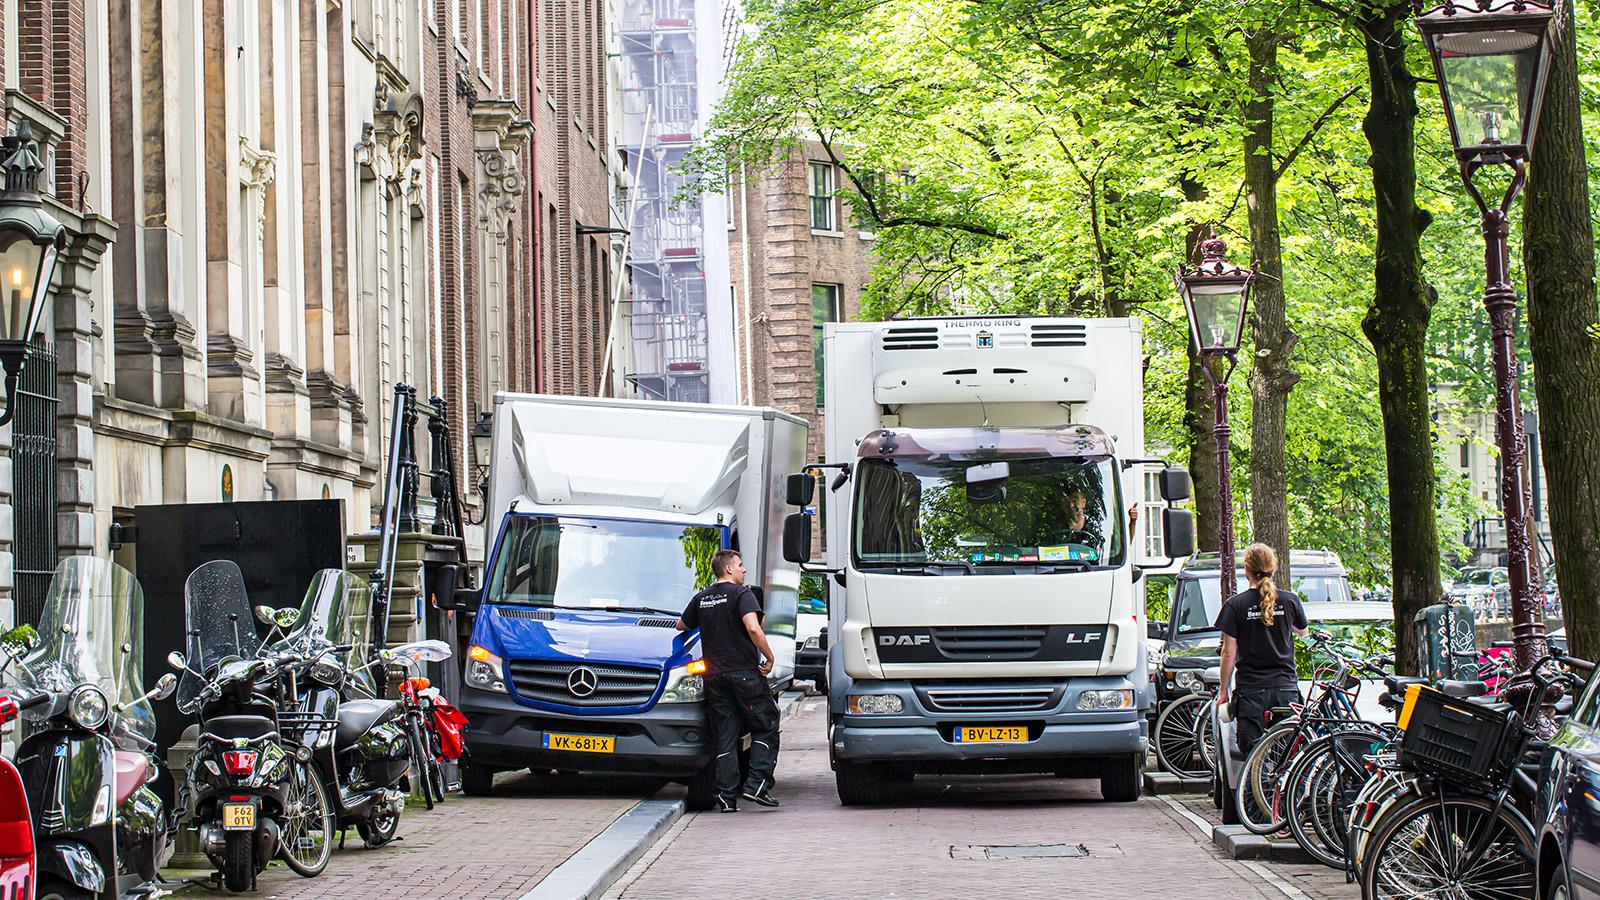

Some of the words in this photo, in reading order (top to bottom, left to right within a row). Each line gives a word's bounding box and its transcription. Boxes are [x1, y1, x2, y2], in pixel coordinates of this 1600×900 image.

[944, 320, 991, 328] THERMO
[994, 319, 1021, 327] KING
[879, 635, 930, 646] DAF
[1066, 633, 1101, 643] LF
[968, 729, 1020, 740] BV-LZ-13
[555, 737, 608, 750] VK-681-X
[234, 807, 252, 815] F62
